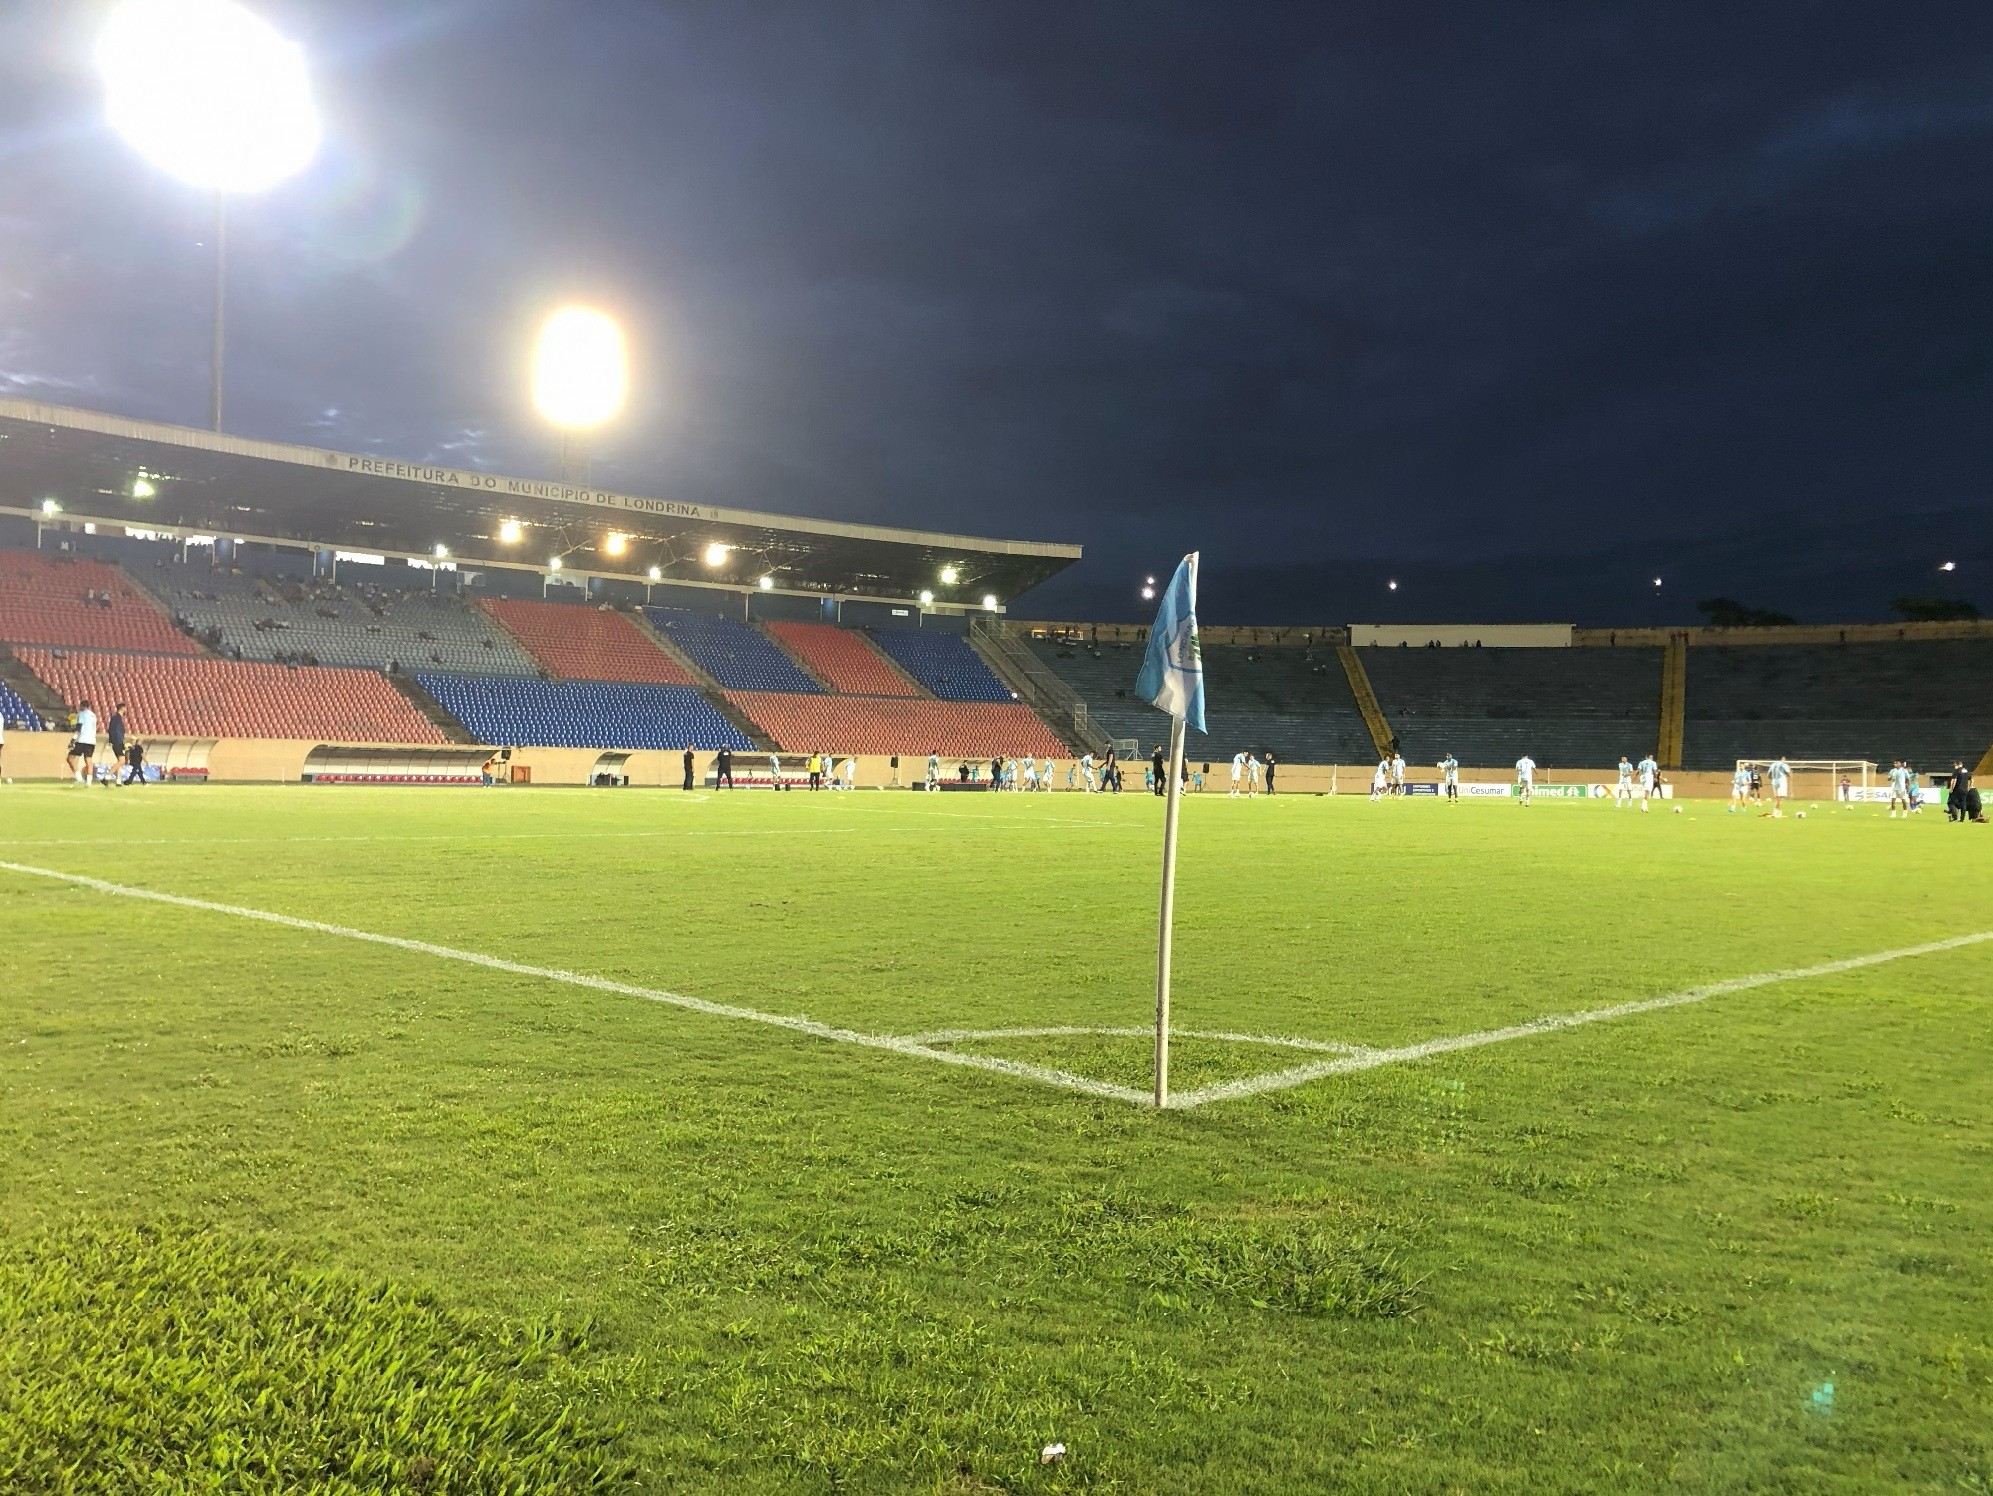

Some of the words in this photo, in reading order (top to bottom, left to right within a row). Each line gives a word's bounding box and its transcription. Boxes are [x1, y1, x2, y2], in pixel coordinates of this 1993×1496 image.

[349, 457, 460, 484] PREFEITURA
[470, 475, 497, 489] DO
[596, 493, 616, 505] DE
[624, 497, 701, 517] LONDRINA
[1458, 786, 1504, 795] UniCesumar
